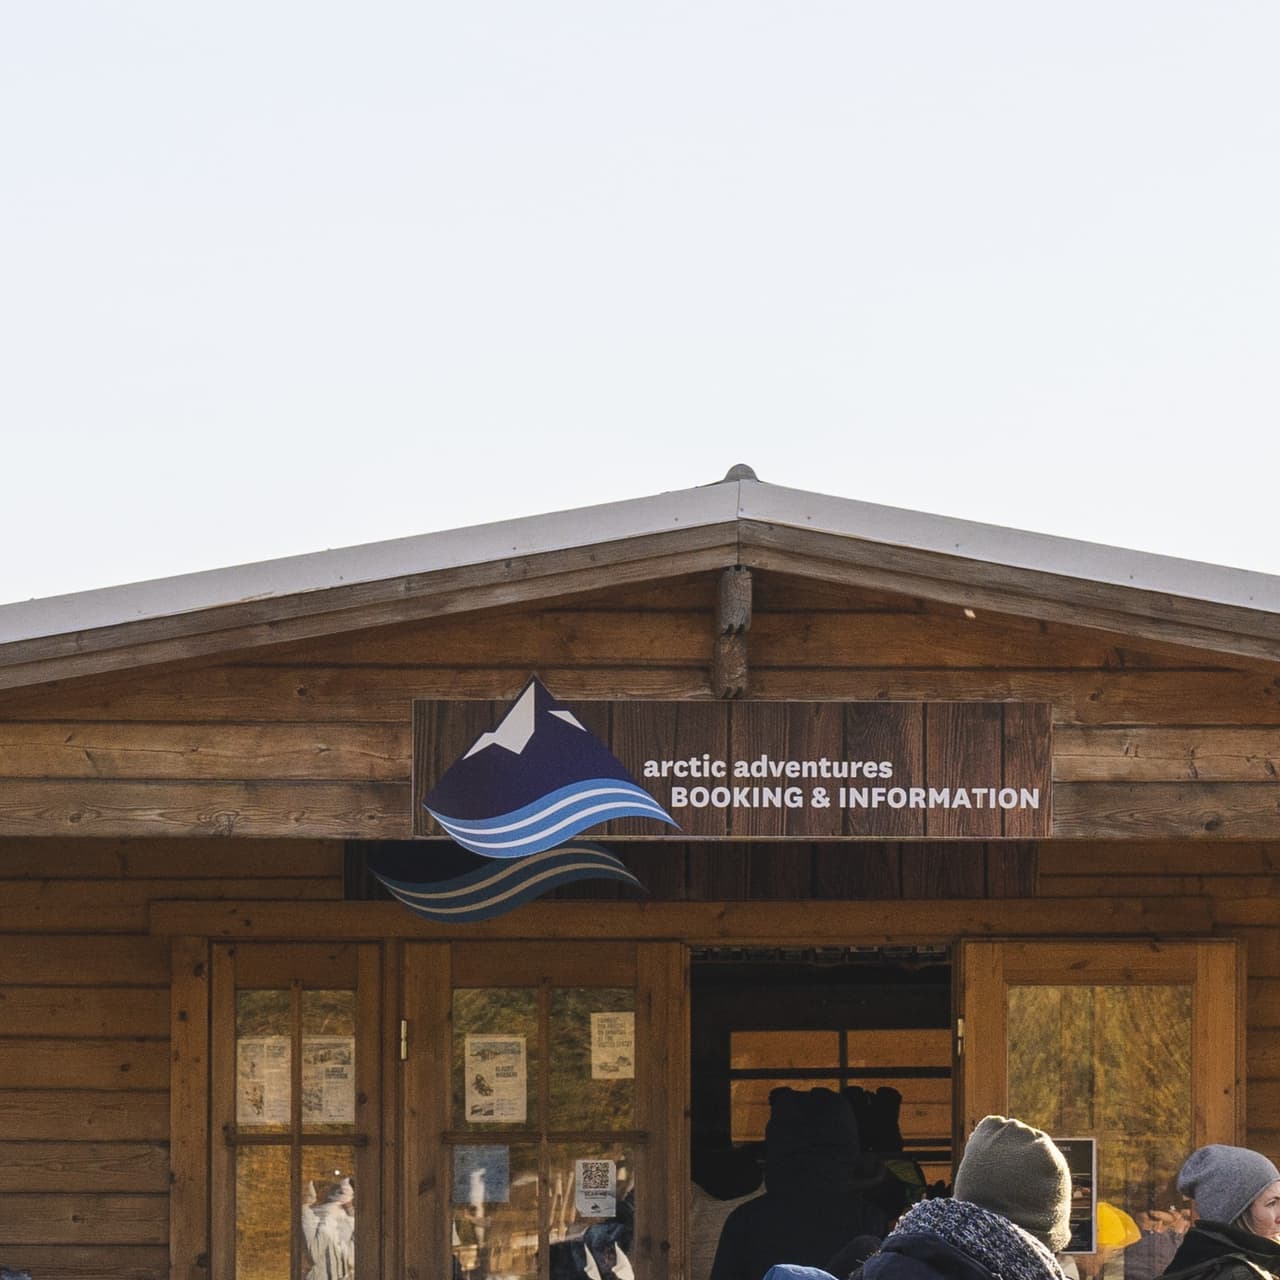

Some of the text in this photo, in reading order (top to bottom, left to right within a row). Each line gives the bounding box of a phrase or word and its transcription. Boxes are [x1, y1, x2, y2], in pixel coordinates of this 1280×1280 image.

[643, 754, 894, 779] arctic adventures
[671, 786, 1040, 810] BOOKING & INFORMATION
